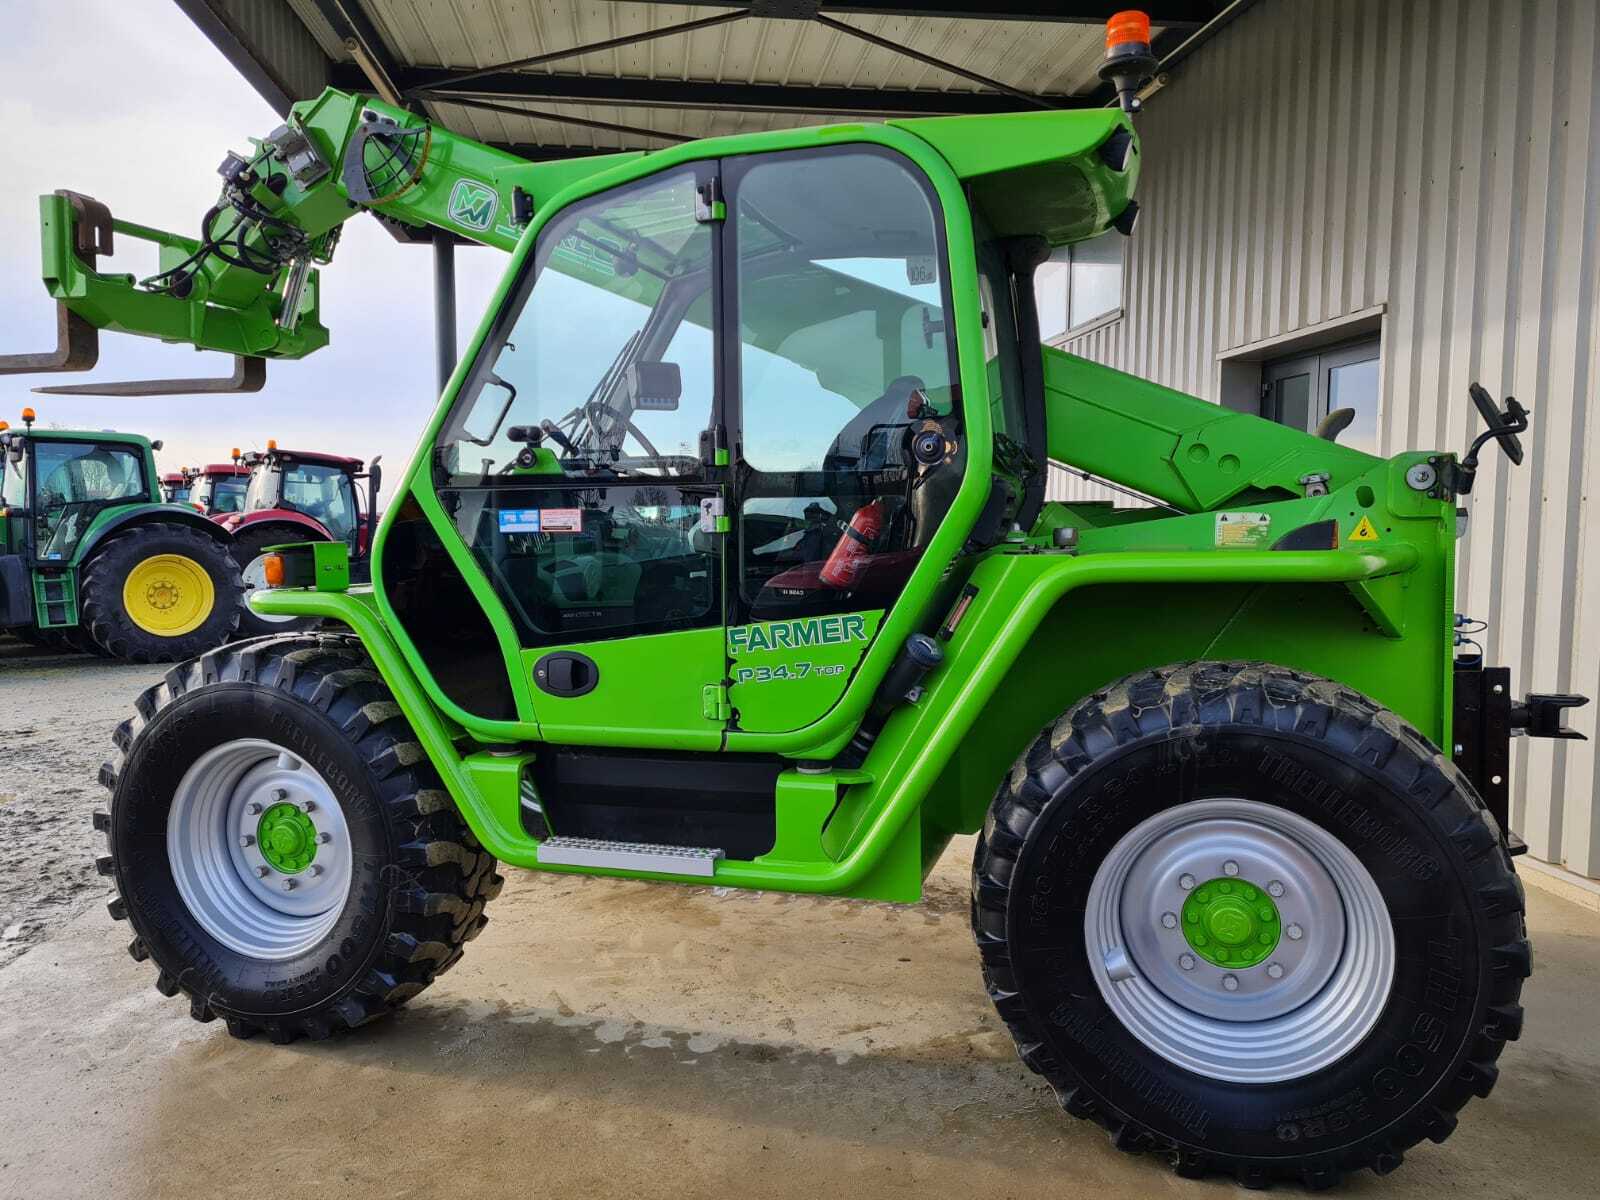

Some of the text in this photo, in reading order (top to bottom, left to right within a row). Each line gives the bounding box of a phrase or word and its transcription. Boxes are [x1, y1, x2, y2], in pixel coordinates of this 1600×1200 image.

[727, 614, 867, 654] FARMER
[736, 662, 845, 685] P34.7 TOP
